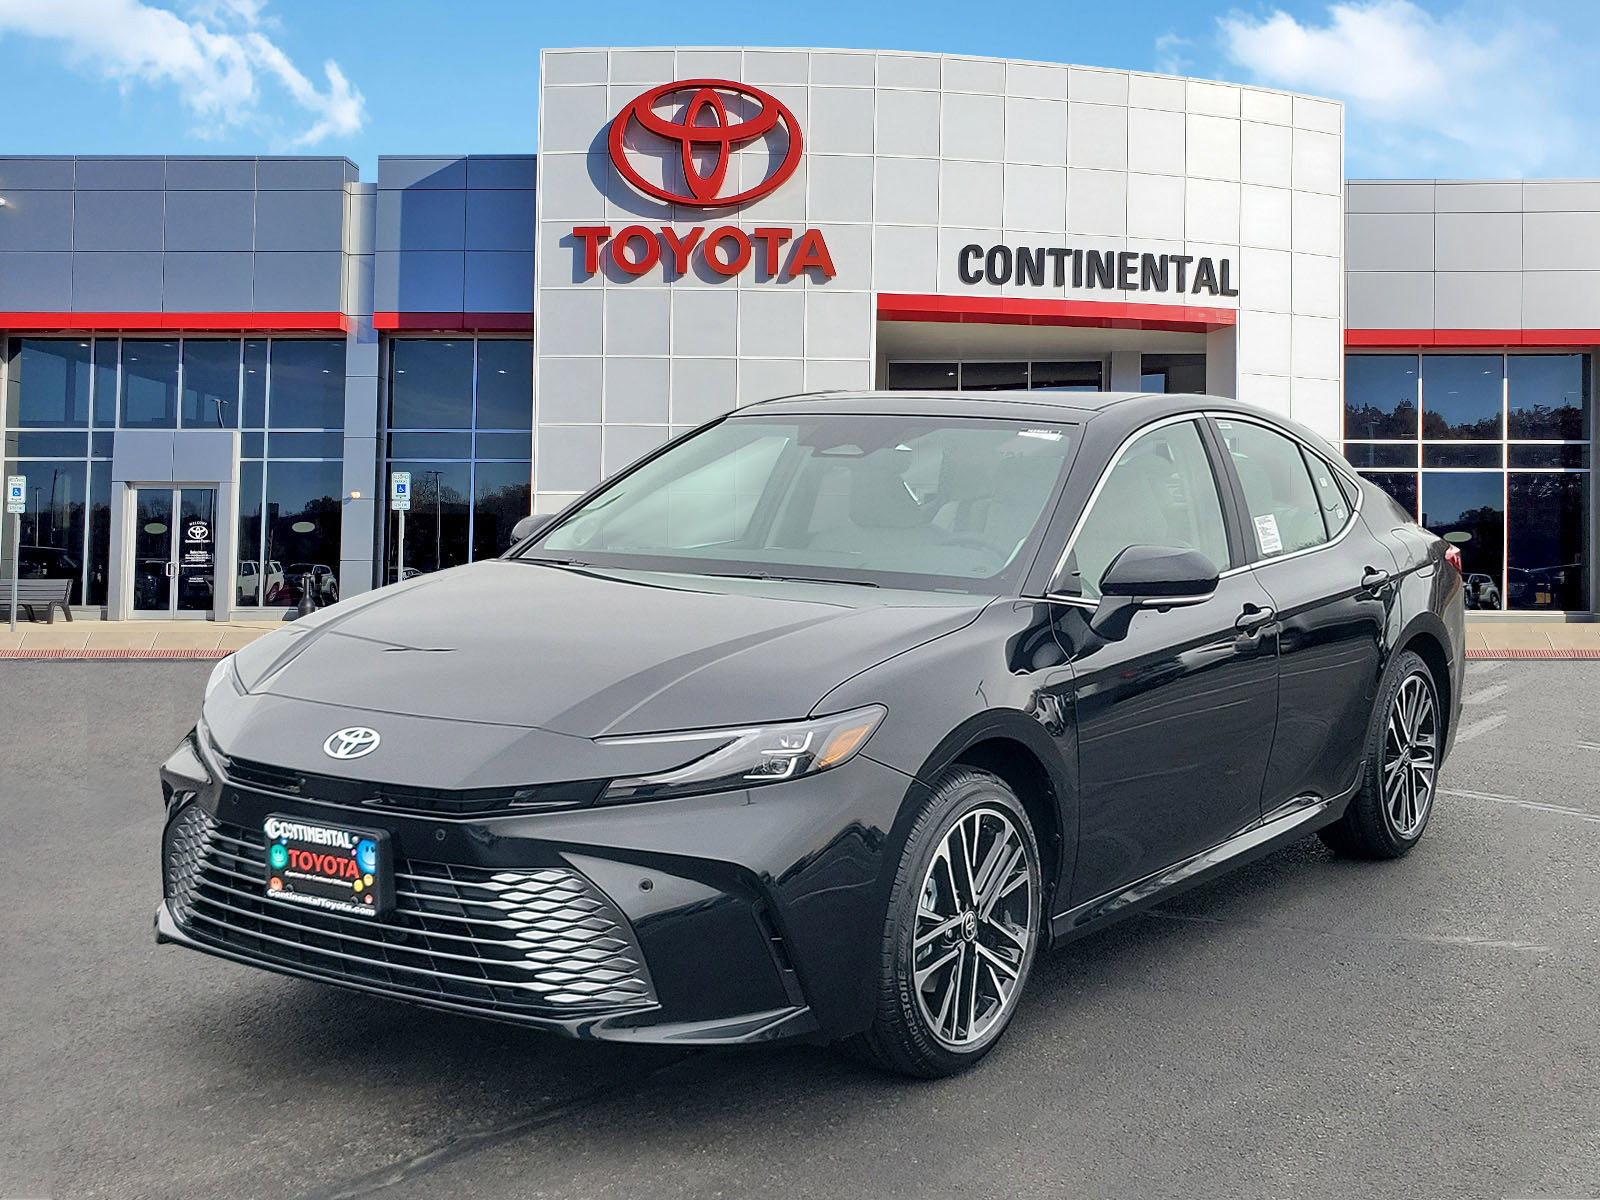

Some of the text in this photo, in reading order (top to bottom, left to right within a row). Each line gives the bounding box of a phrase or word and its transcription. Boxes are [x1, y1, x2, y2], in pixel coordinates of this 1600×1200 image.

[573, 225, 837, 276] TOYOTA
[959, 244, 1239, 297] CONTINENTAL
[264, 818, 353, 848] CONTINENTAL
[288, 849, 360, 879] TOYOTA
[267, 889, 376, 916] ContinentalToyota.com
